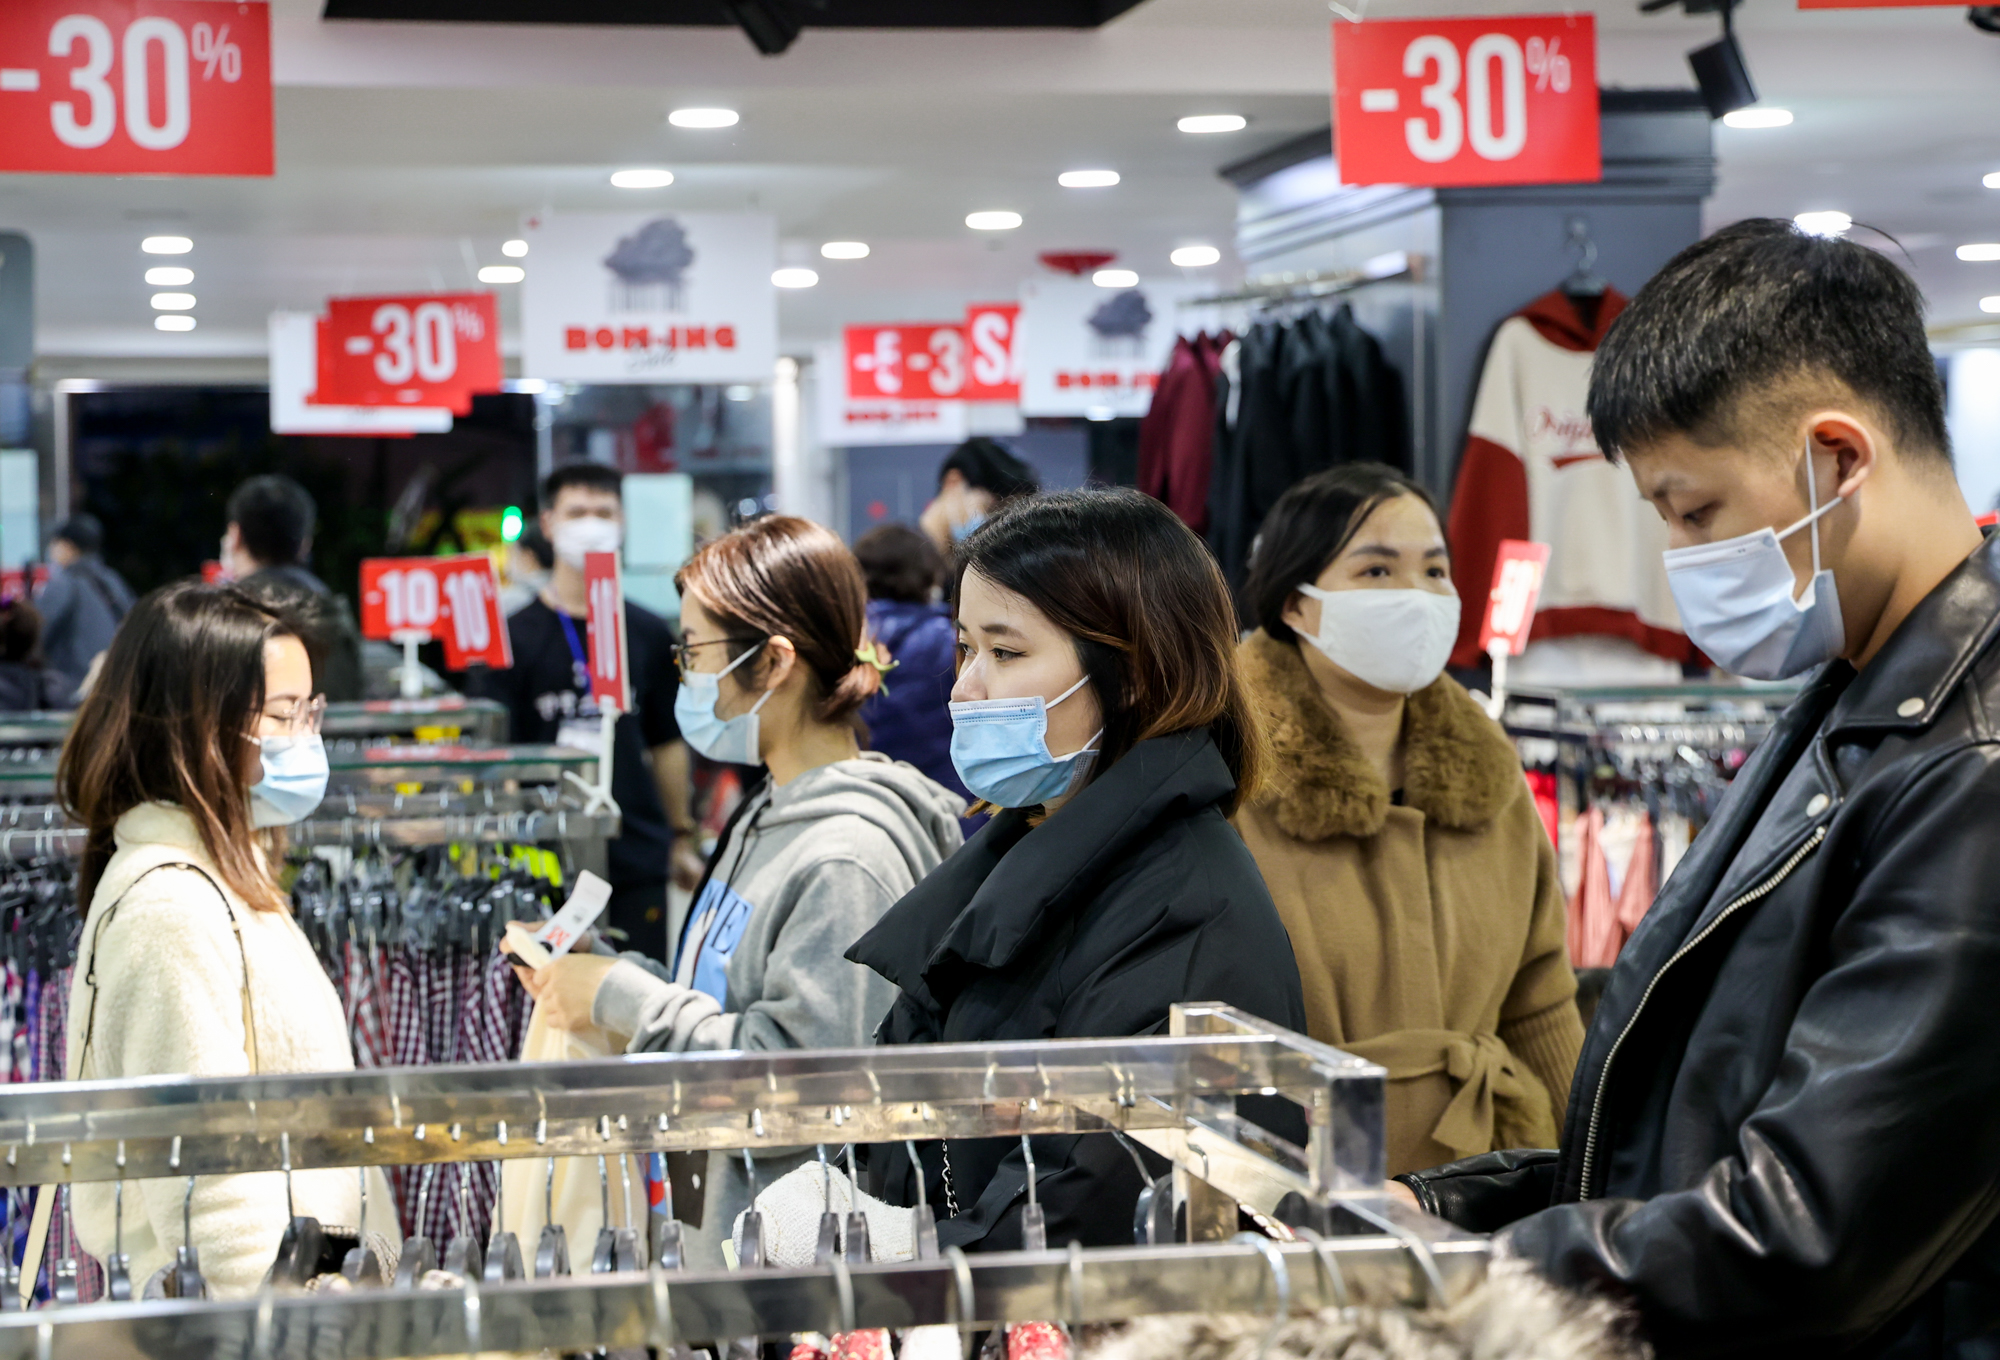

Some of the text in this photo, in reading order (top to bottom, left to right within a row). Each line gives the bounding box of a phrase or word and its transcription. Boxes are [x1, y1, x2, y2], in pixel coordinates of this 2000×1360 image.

[0, 14, 242, 150] -30%
[1360, 33, 1571, 163] -30%
[345, 301, 485, 385] -30%
